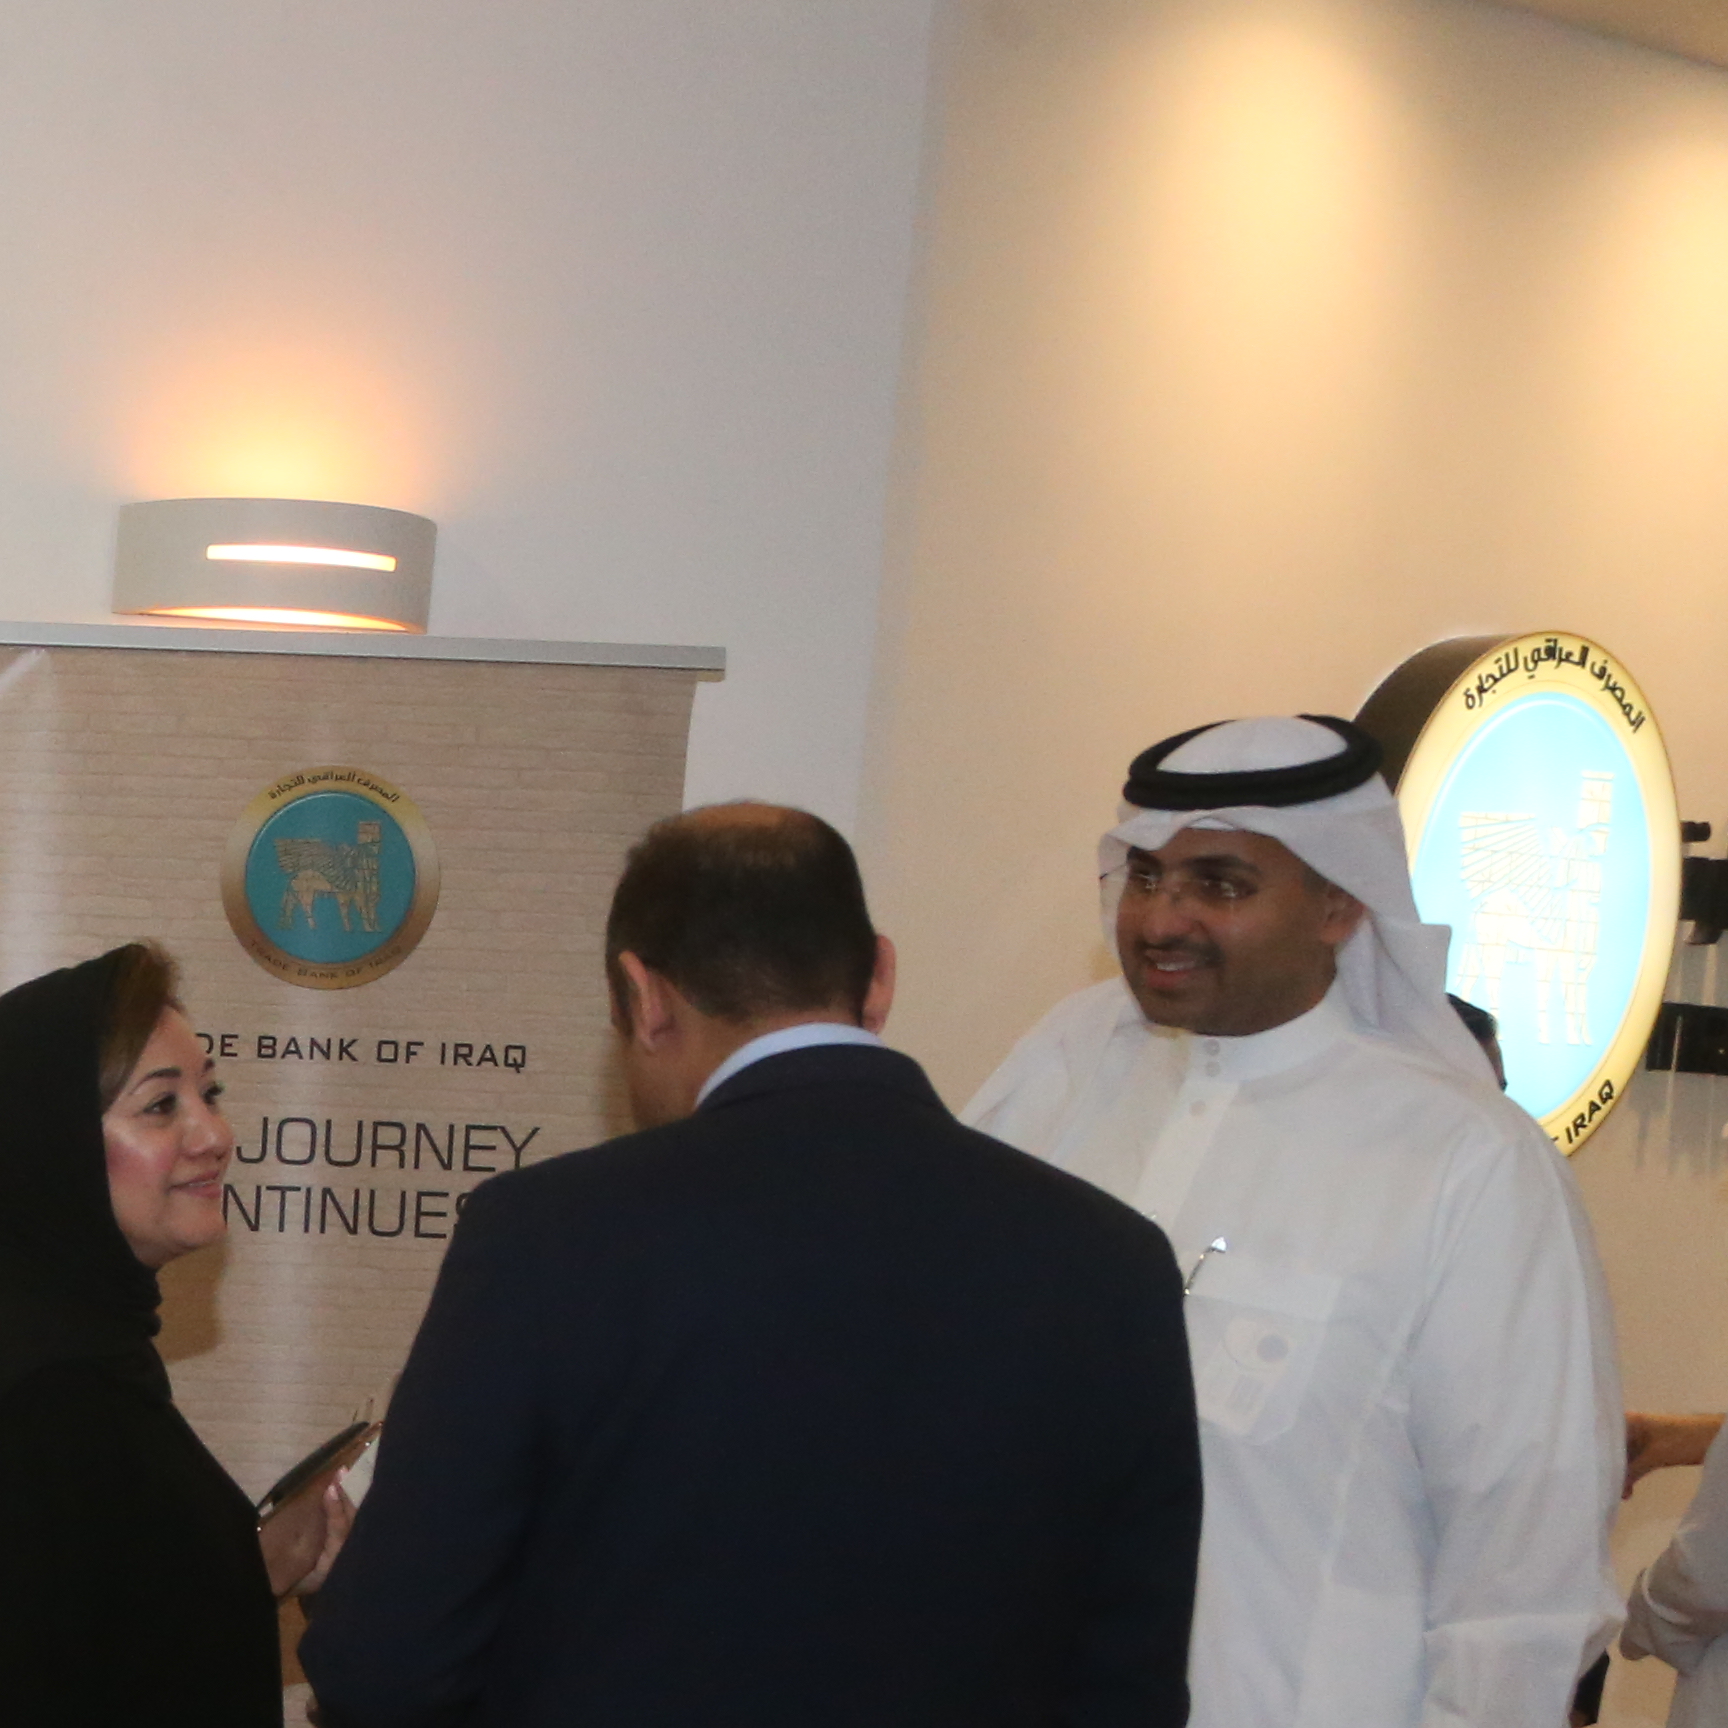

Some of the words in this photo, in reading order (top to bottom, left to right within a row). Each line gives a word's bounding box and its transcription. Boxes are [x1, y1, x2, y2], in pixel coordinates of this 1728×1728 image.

[1524, 638, 1590, 680] العراقي
[1590, 659, 1646, 734] المصرف
[257, 1035, 359, 1063] BANK
[376, 1039, 424, 1063] OF
[440, 1042, 527, 1073] IRAQ
[1565, 1079, 1614, 1144] IRAQ
[236, 1116, 541, 1172] JOURNEY
[222, 1183, 474, 1239] NTINUE
